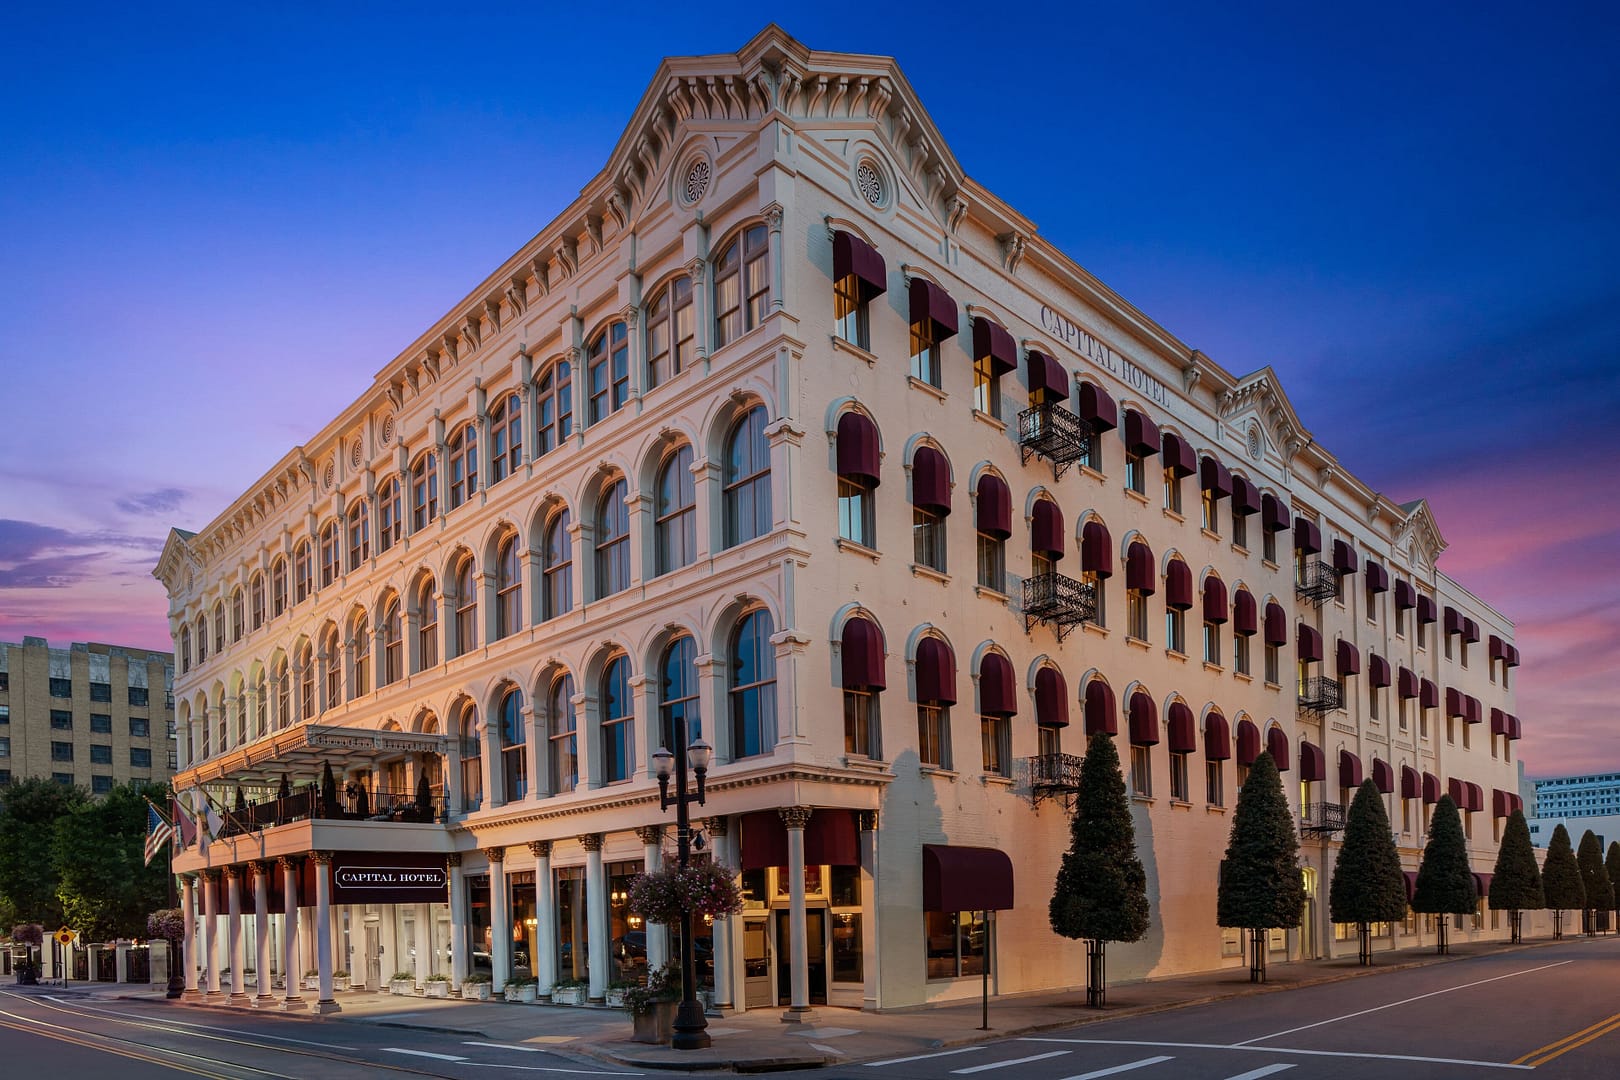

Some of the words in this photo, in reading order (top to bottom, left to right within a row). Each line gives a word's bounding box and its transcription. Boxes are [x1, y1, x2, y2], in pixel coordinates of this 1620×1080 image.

[1040, 304, 1117, 374] CAPITAL
[1122, 357, 1170, 408] HOTEL
[342, 873, 396, 882] CAPITAL
[399, 873, 441, 882] HOTEL
